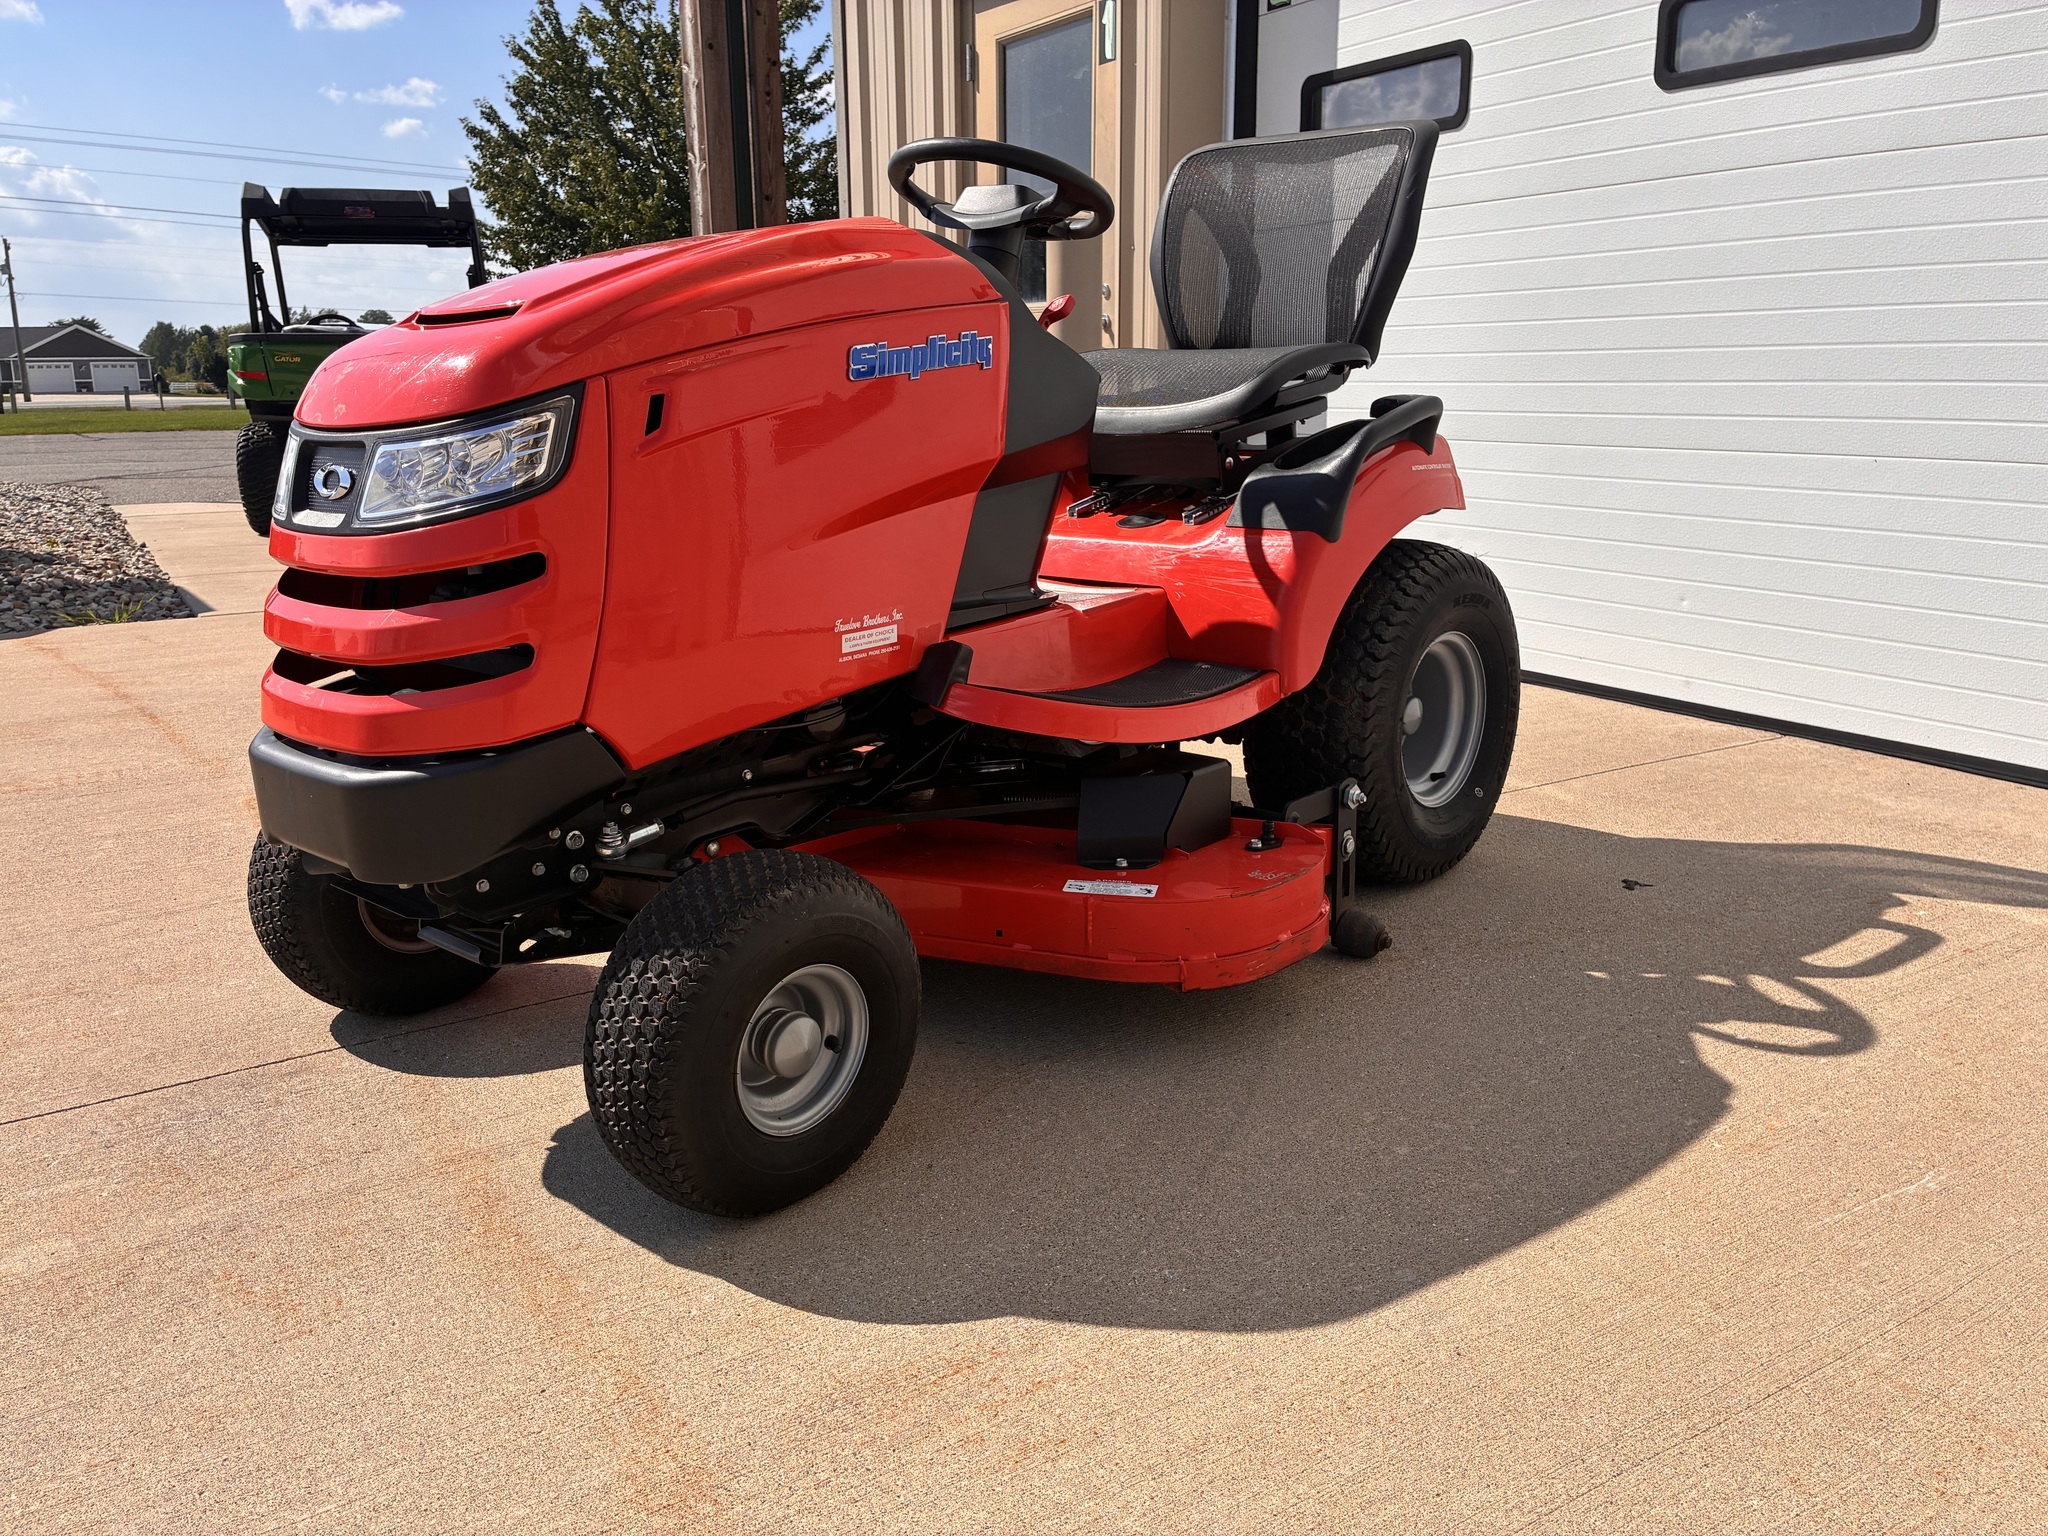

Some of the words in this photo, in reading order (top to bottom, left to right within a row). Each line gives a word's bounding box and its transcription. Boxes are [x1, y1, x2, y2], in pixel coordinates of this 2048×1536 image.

[274, 355, 301, 363] GATOR
[849, 330, 993, 381] Simplicity
[834, 617, 862, 633] Truelove
[863, 612, 892, 628] Brothers,
[892, 609, 903, 621] Inc.
[844, 634, 866, 643] DEALER
[875, 628, 894, 636] CHOICE
